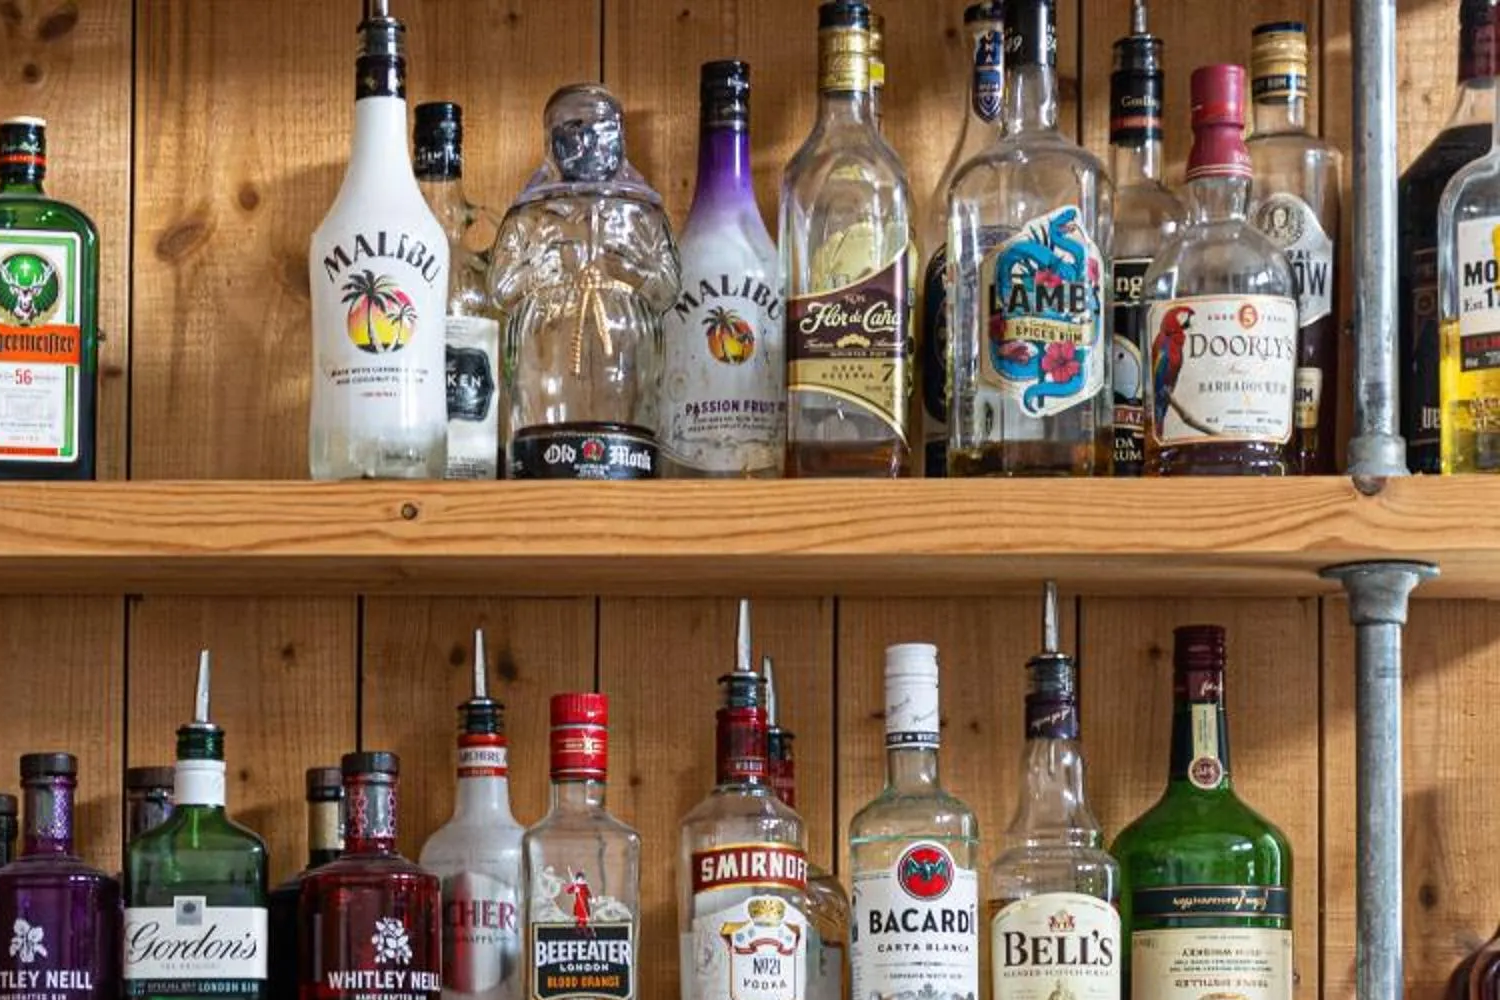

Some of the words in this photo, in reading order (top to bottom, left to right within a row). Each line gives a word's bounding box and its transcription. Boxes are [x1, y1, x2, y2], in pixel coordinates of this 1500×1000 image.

[323, 231, 442, 284] MALIBU
[673, 274, 786, 324] MALIBU
[800, 302, 847, 334] Flor
[848, 311, 863, 324] de
[862, 301, 902, 333] Caña
[15, 367, 33, 386] 56
[684, 400, 741, 417] PASSION
[544, 445, 577, 465] Old
[127, 920, 258, 964] Gordon's
[1003, 929, 1113, 968] BELL'S
[535, 939, 631, 968] BEEFEATER
[559, 963, 610, 972] LONDON
[45, 969, 93, 990] NEILL
[327, 970, 407, 990] WHITLEY
[410, 970, 441, 992] NEILL
[742, 978, 788, 990] VODKA
